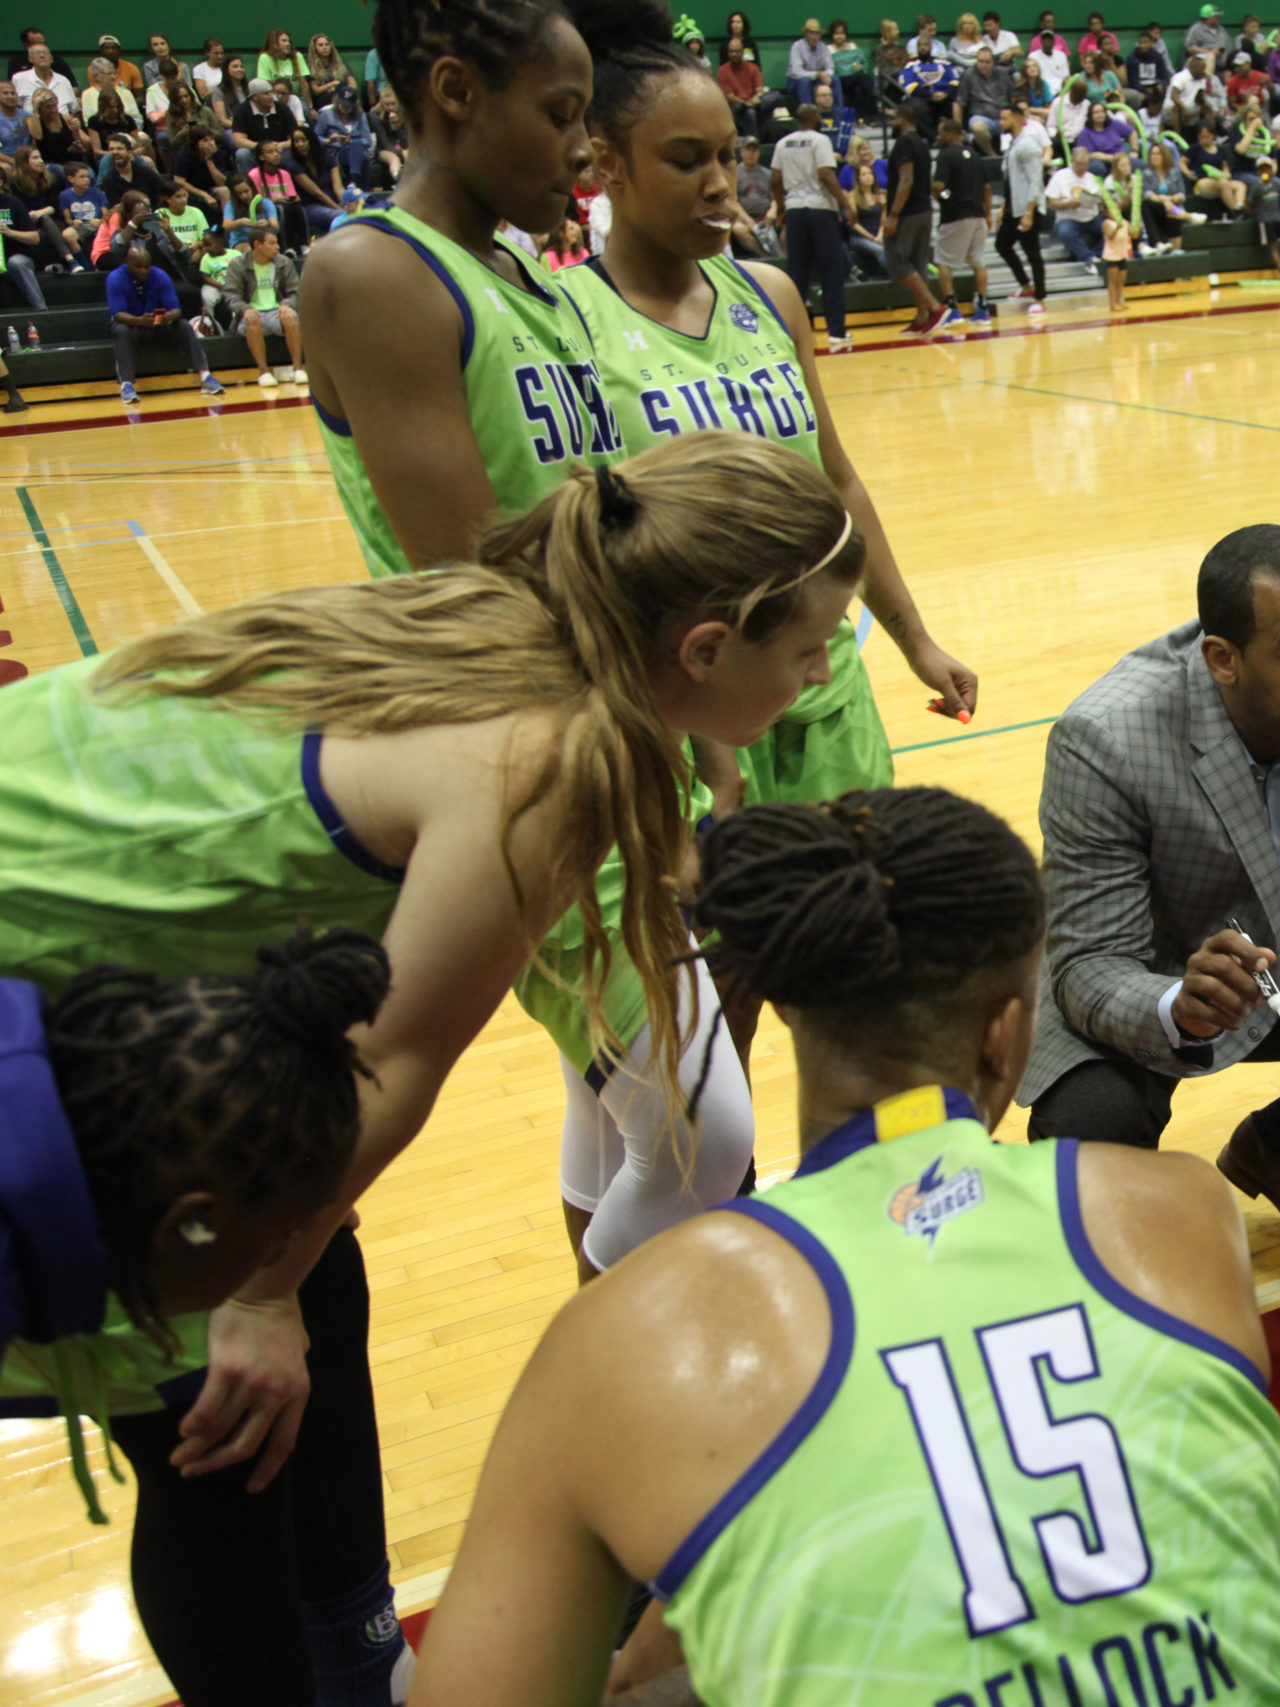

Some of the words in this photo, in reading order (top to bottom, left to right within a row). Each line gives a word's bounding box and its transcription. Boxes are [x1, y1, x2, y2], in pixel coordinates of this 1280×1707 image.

[639, 363, 684, 382] ST.
[715, 343, 778, 375] OUIS
[638, 361, 818, 438] SURGE
[913, 1178, 978, 1224] SURGE
[878, 1302, 1154, 1640] 15
